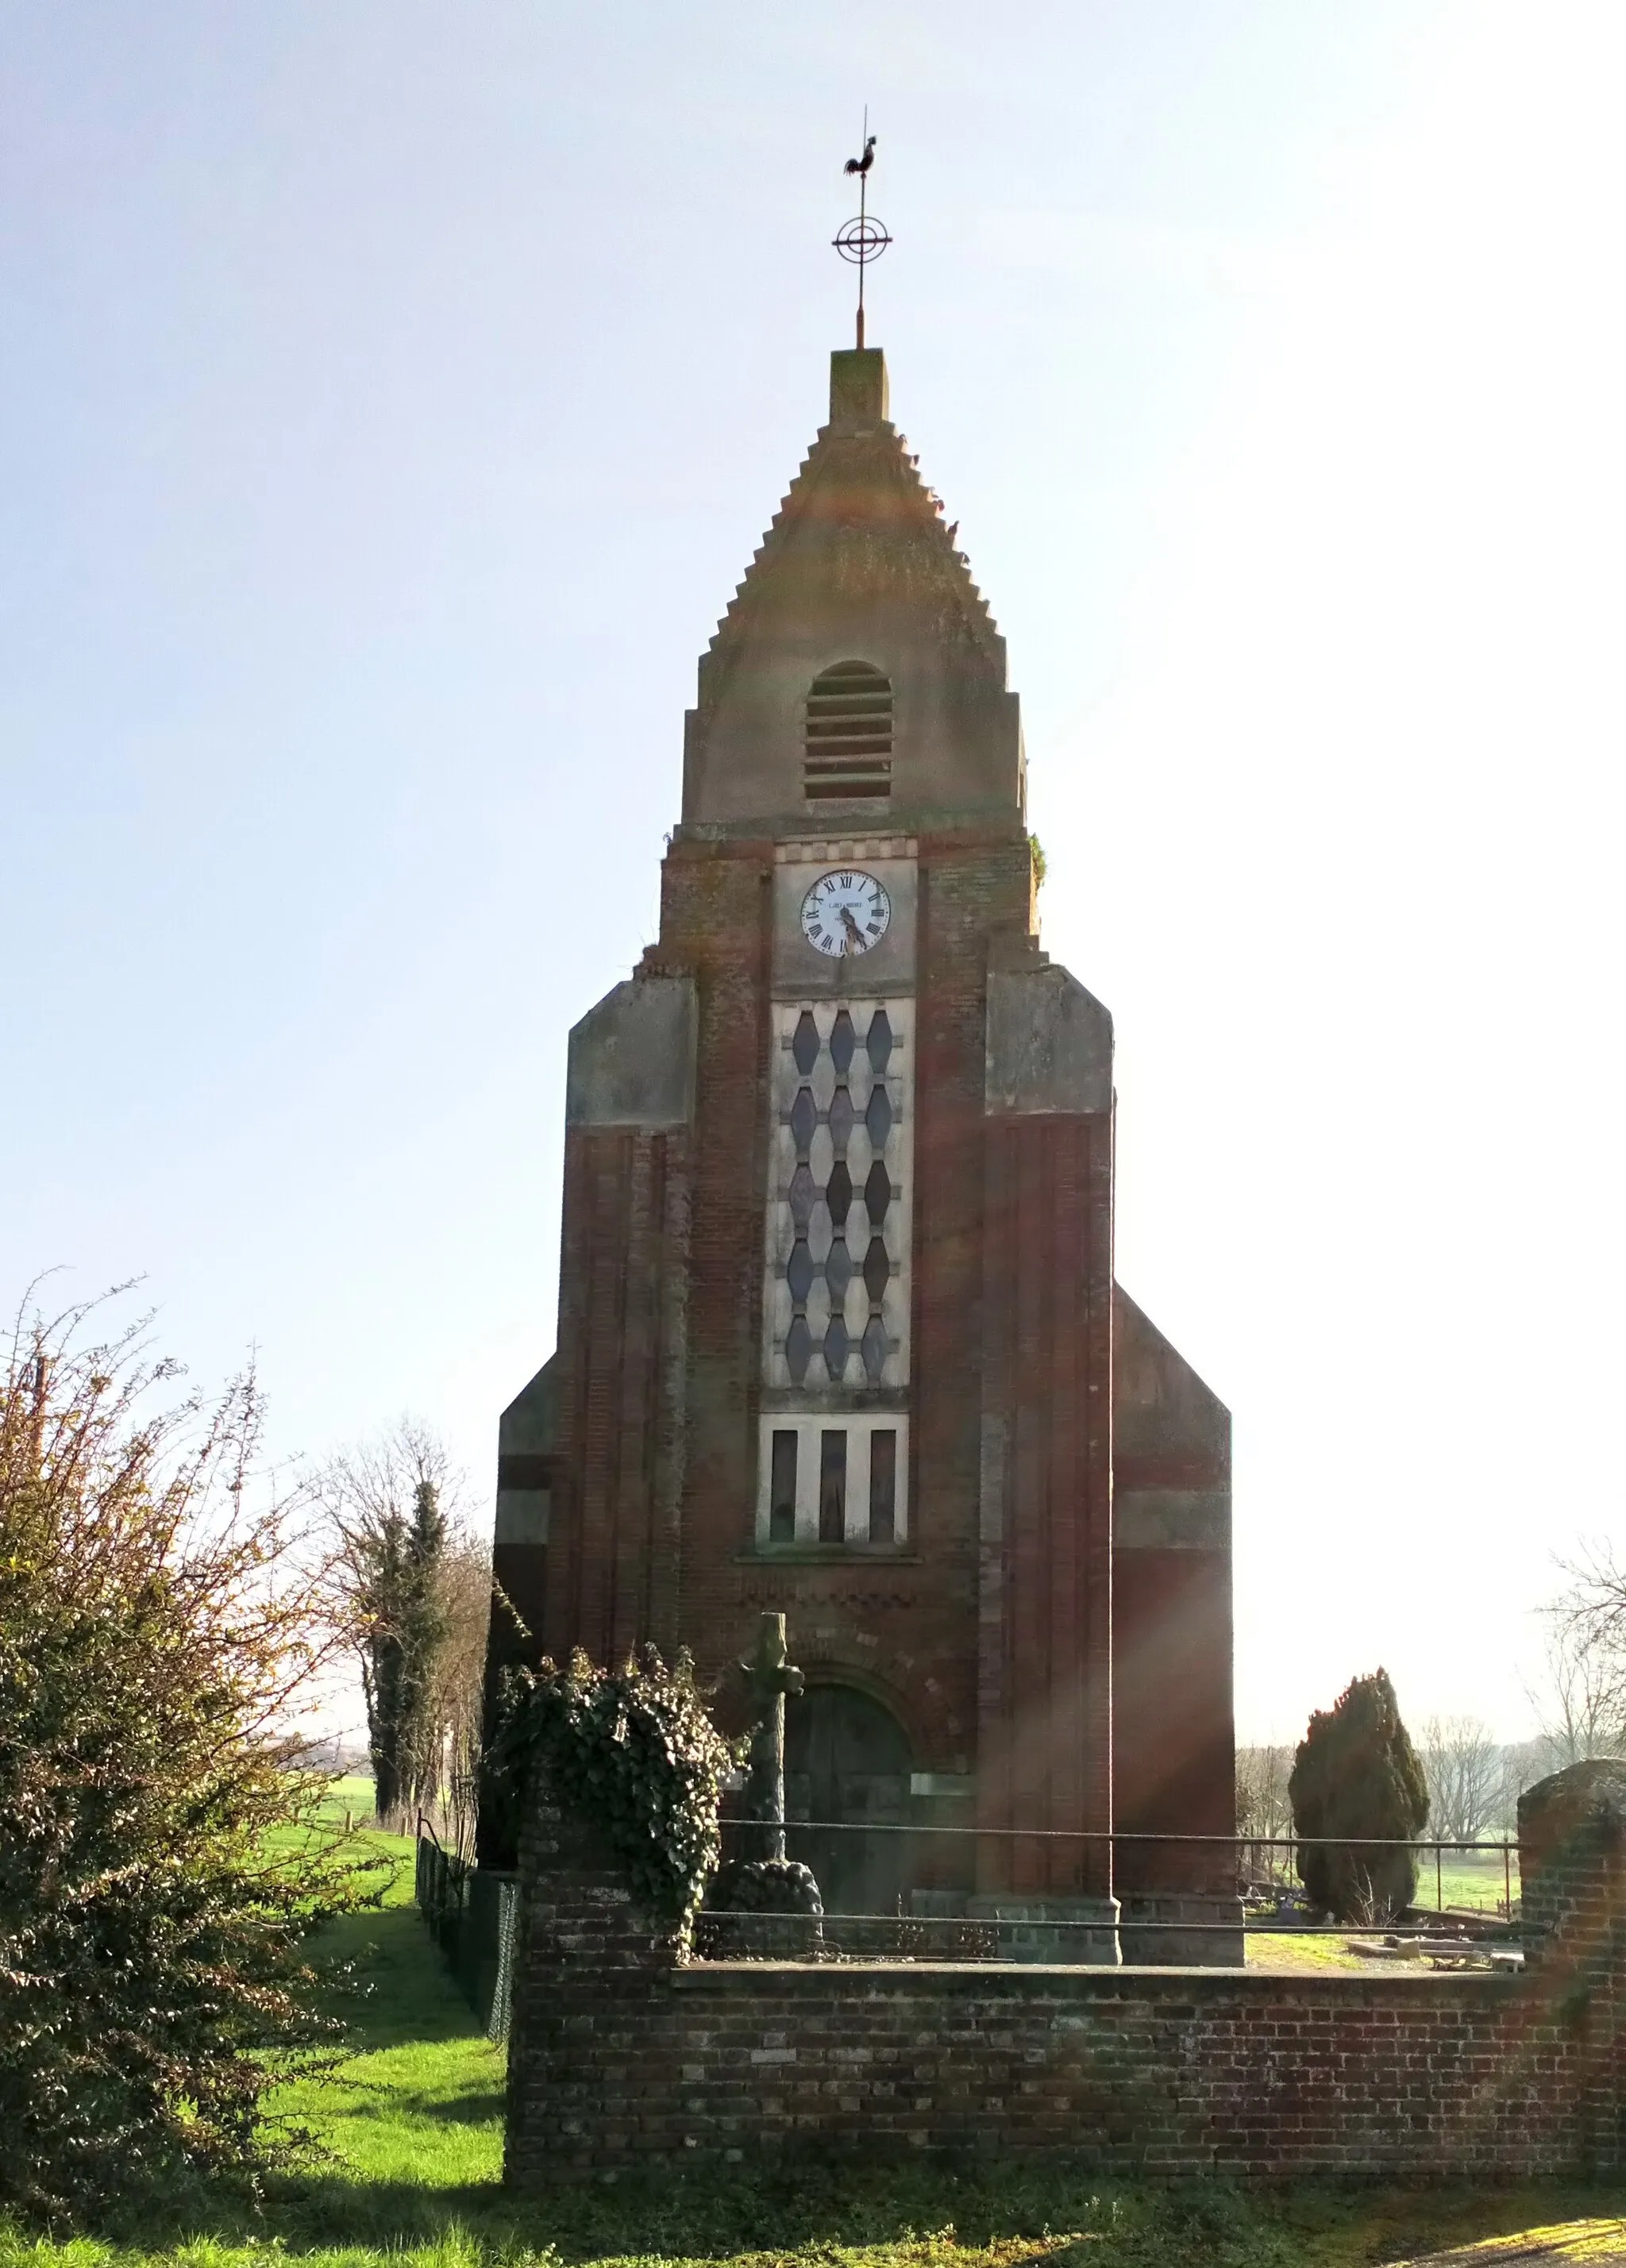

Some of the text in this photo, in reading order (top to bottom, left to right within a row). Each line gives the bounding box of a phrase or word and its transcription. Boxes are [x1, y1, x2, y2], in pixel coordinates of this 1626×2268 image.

[823, 880, 836, 894] XI
[840, 876, 853, 889] XII
[858, 880, 867, 891] I
[811, 894, 823, 904] X
[868, 892, 880, 902] II
[806, 910, 819, 918] IX
[821, 934, 833, 949] VII
